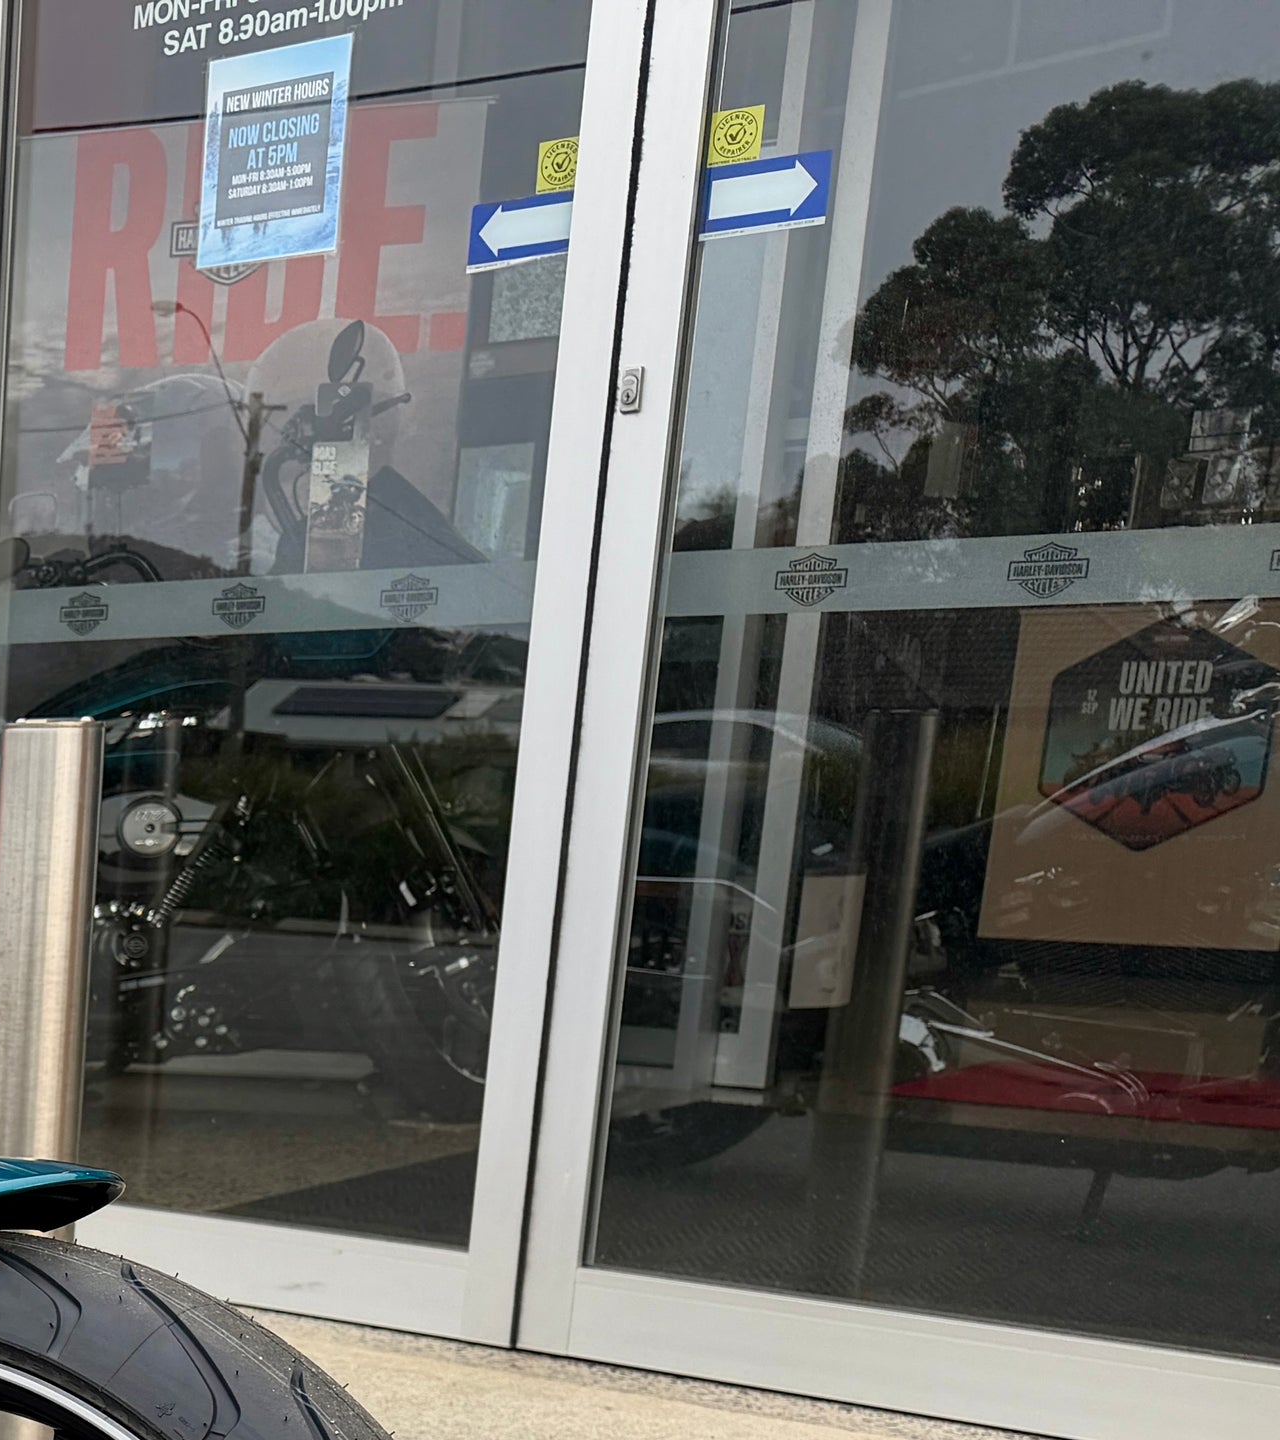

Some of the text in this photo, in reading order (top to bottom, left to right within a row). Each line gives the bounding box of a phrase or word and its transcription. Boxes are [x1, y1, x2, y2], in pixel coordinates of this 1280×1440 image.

[163, 23, 213, 56] SAT
[226, 78, 330, 113] NEW WINTER HOURS
[719, 114, 754, 130] LICENSED
[228, 113, 320, 149] NOW CLOSING
[246, 141, 298, 170] AT 5PM
[719, 140, 751, 156] REPAIRER
[231, 171, 259, 186] MON-FRI
[228, 184, 261, 200] SATURDAY
[1013, 562, 1084, 578] HARLEY-DAVIDSON
[780, 572, 843, 587] HARLEY-DAVIDSON
[1118, 660, 1215, 695] UNITED
[1082, 702, 1099, 715] SEP
[1107, 697, 1147, 731] WE
[1153, 696, 1216, 731] RIDE
